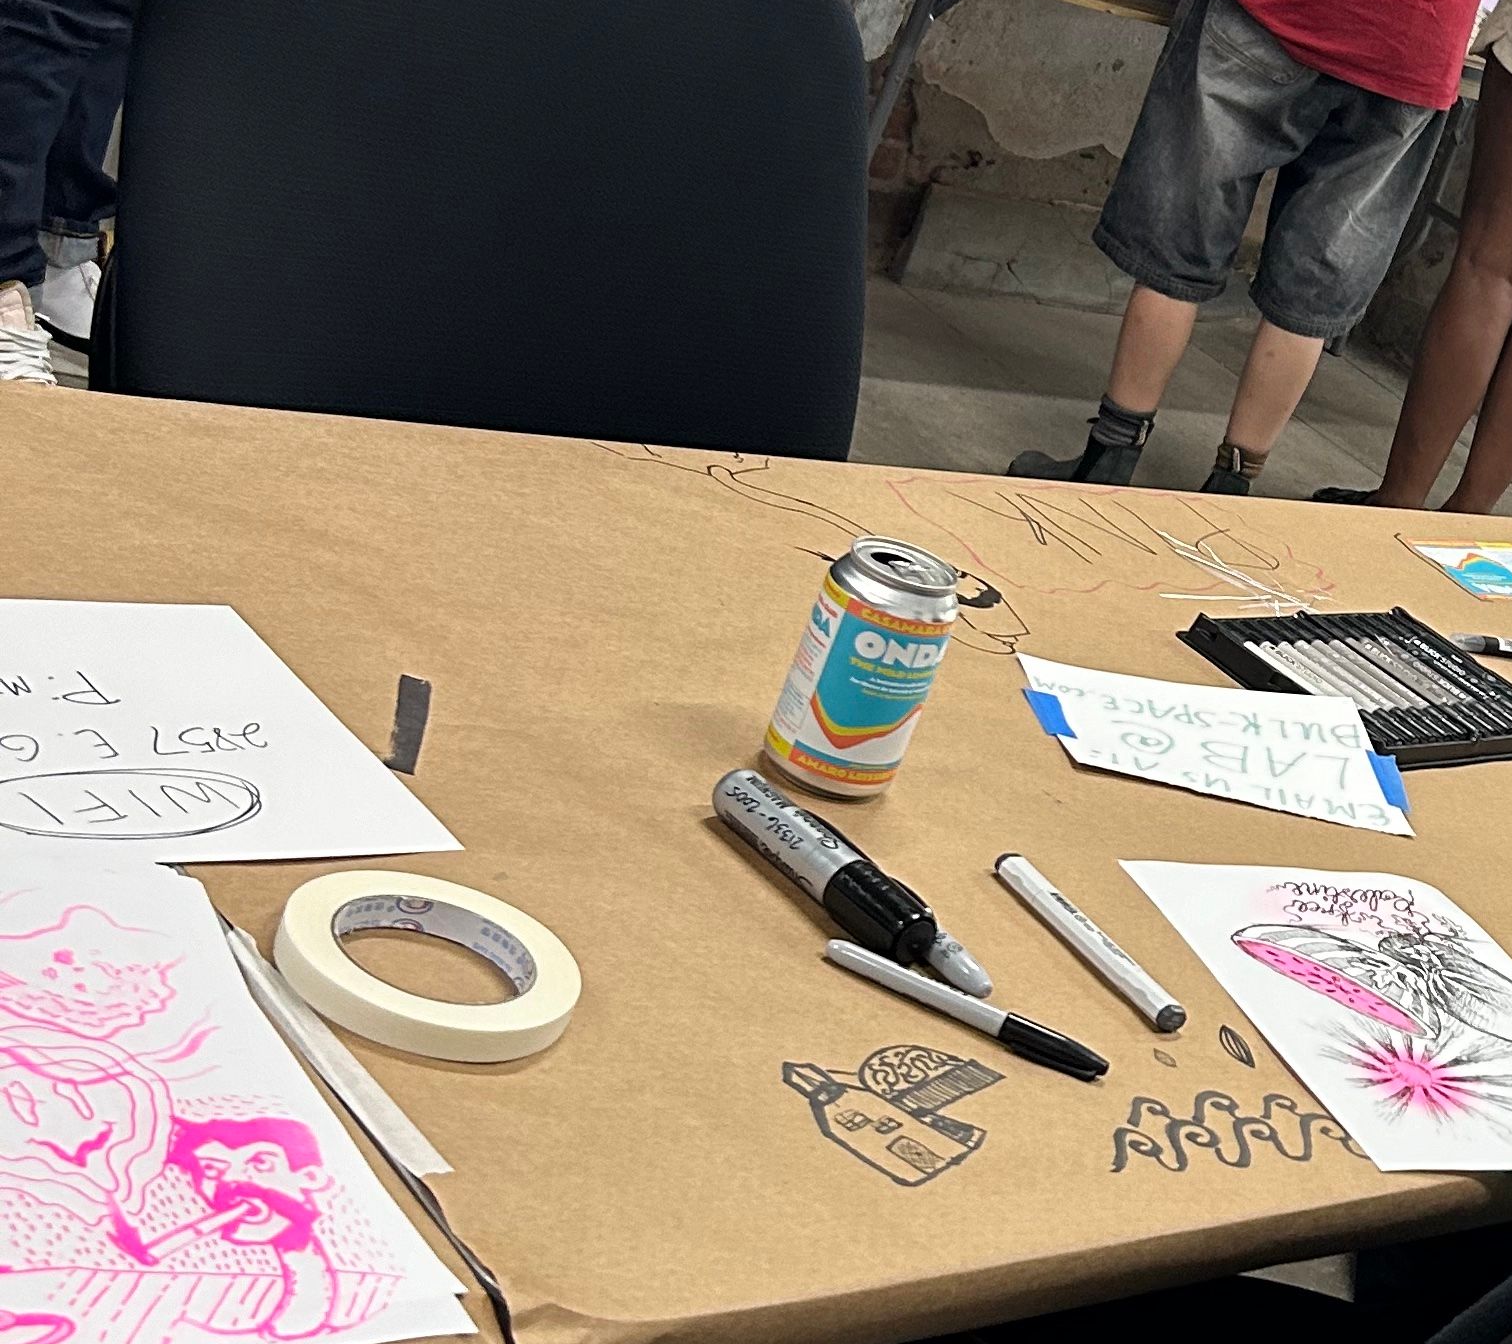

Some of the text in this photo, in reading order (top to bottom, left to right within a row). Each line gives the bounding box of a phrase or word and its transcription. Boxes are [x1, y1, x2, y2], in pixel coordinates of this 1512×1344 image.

[1117, 728, 1348, 788] LAB @
[1180, 767, 1239, 795] US
[18, 778, 241, 827] WIFI
[1246, 780, 1395, 827] EMAIL
